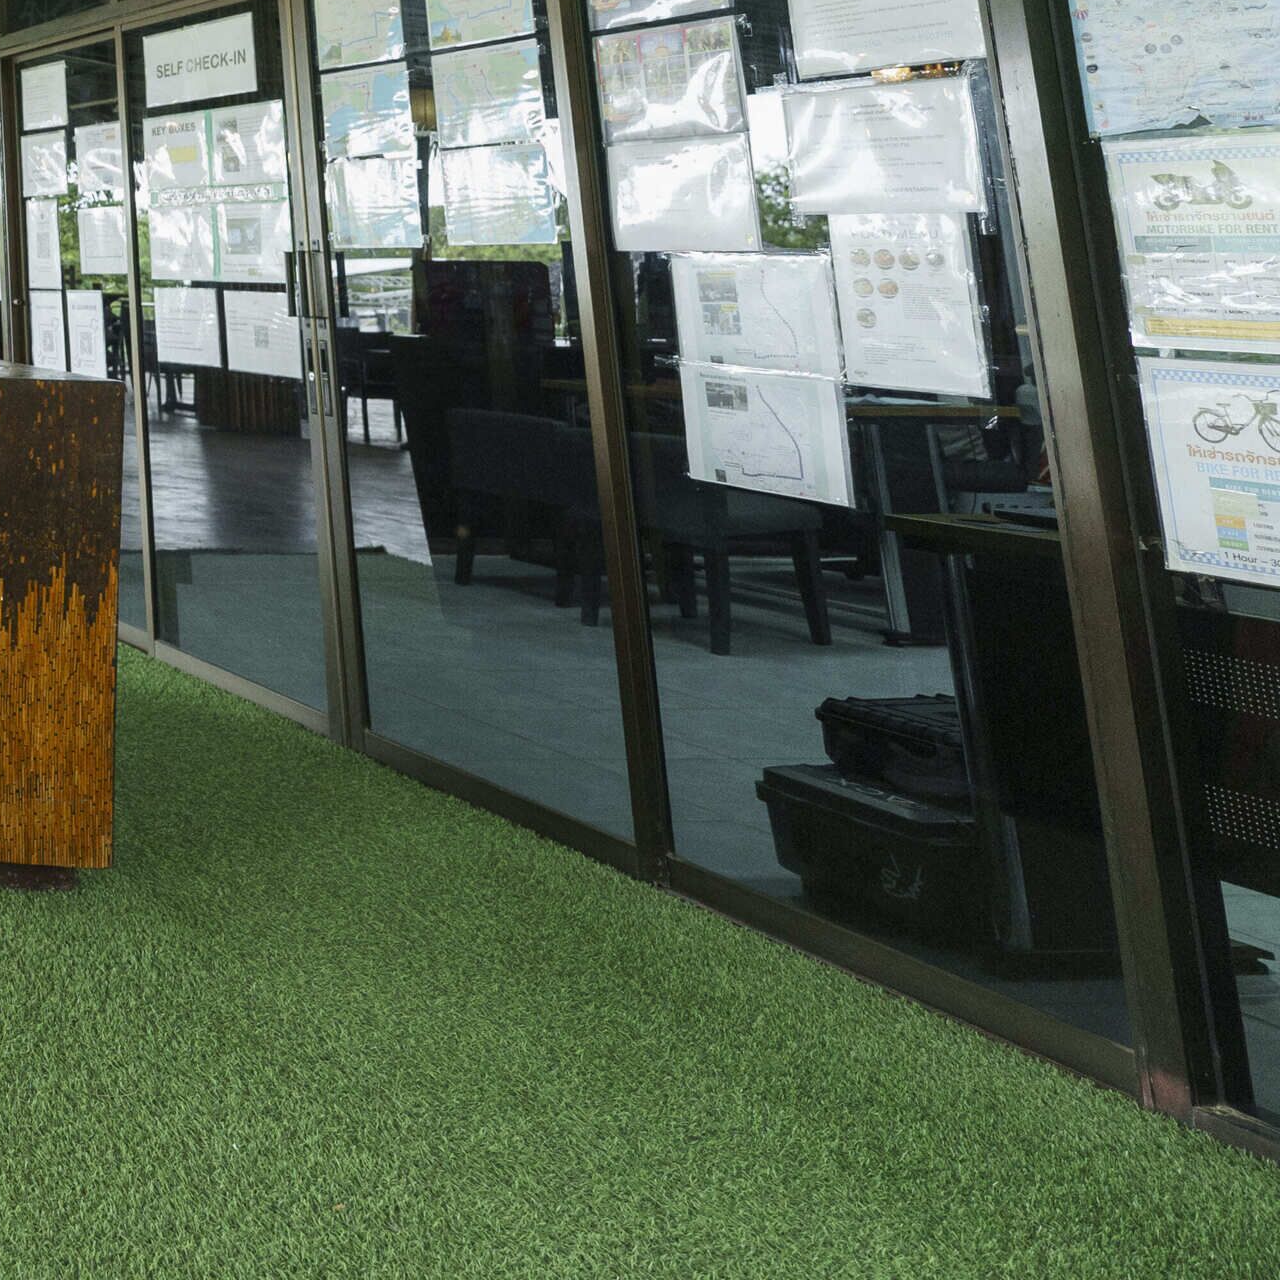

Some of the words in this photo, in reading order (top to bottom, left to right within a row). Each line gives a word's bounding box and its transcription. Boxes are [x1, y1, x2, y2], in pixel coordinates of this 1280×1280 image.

[156, 60, 183, 79] SELF
[185, 48, 247, 73] CHECK-IN
[151, 126, 166, 137] KEY
[168, 122, 196, 135] BOXES
[1146, 223, 1215, 234] MOTORBIKE
[1218, 223, 1242, 234] FOR
[1245, 223, 1278, 234] RENT
[1197, 461, 1231, 475] BIKE
[1232, 465, 1260, 479] FOR
[1232, 553, 1258, 564] Hour
